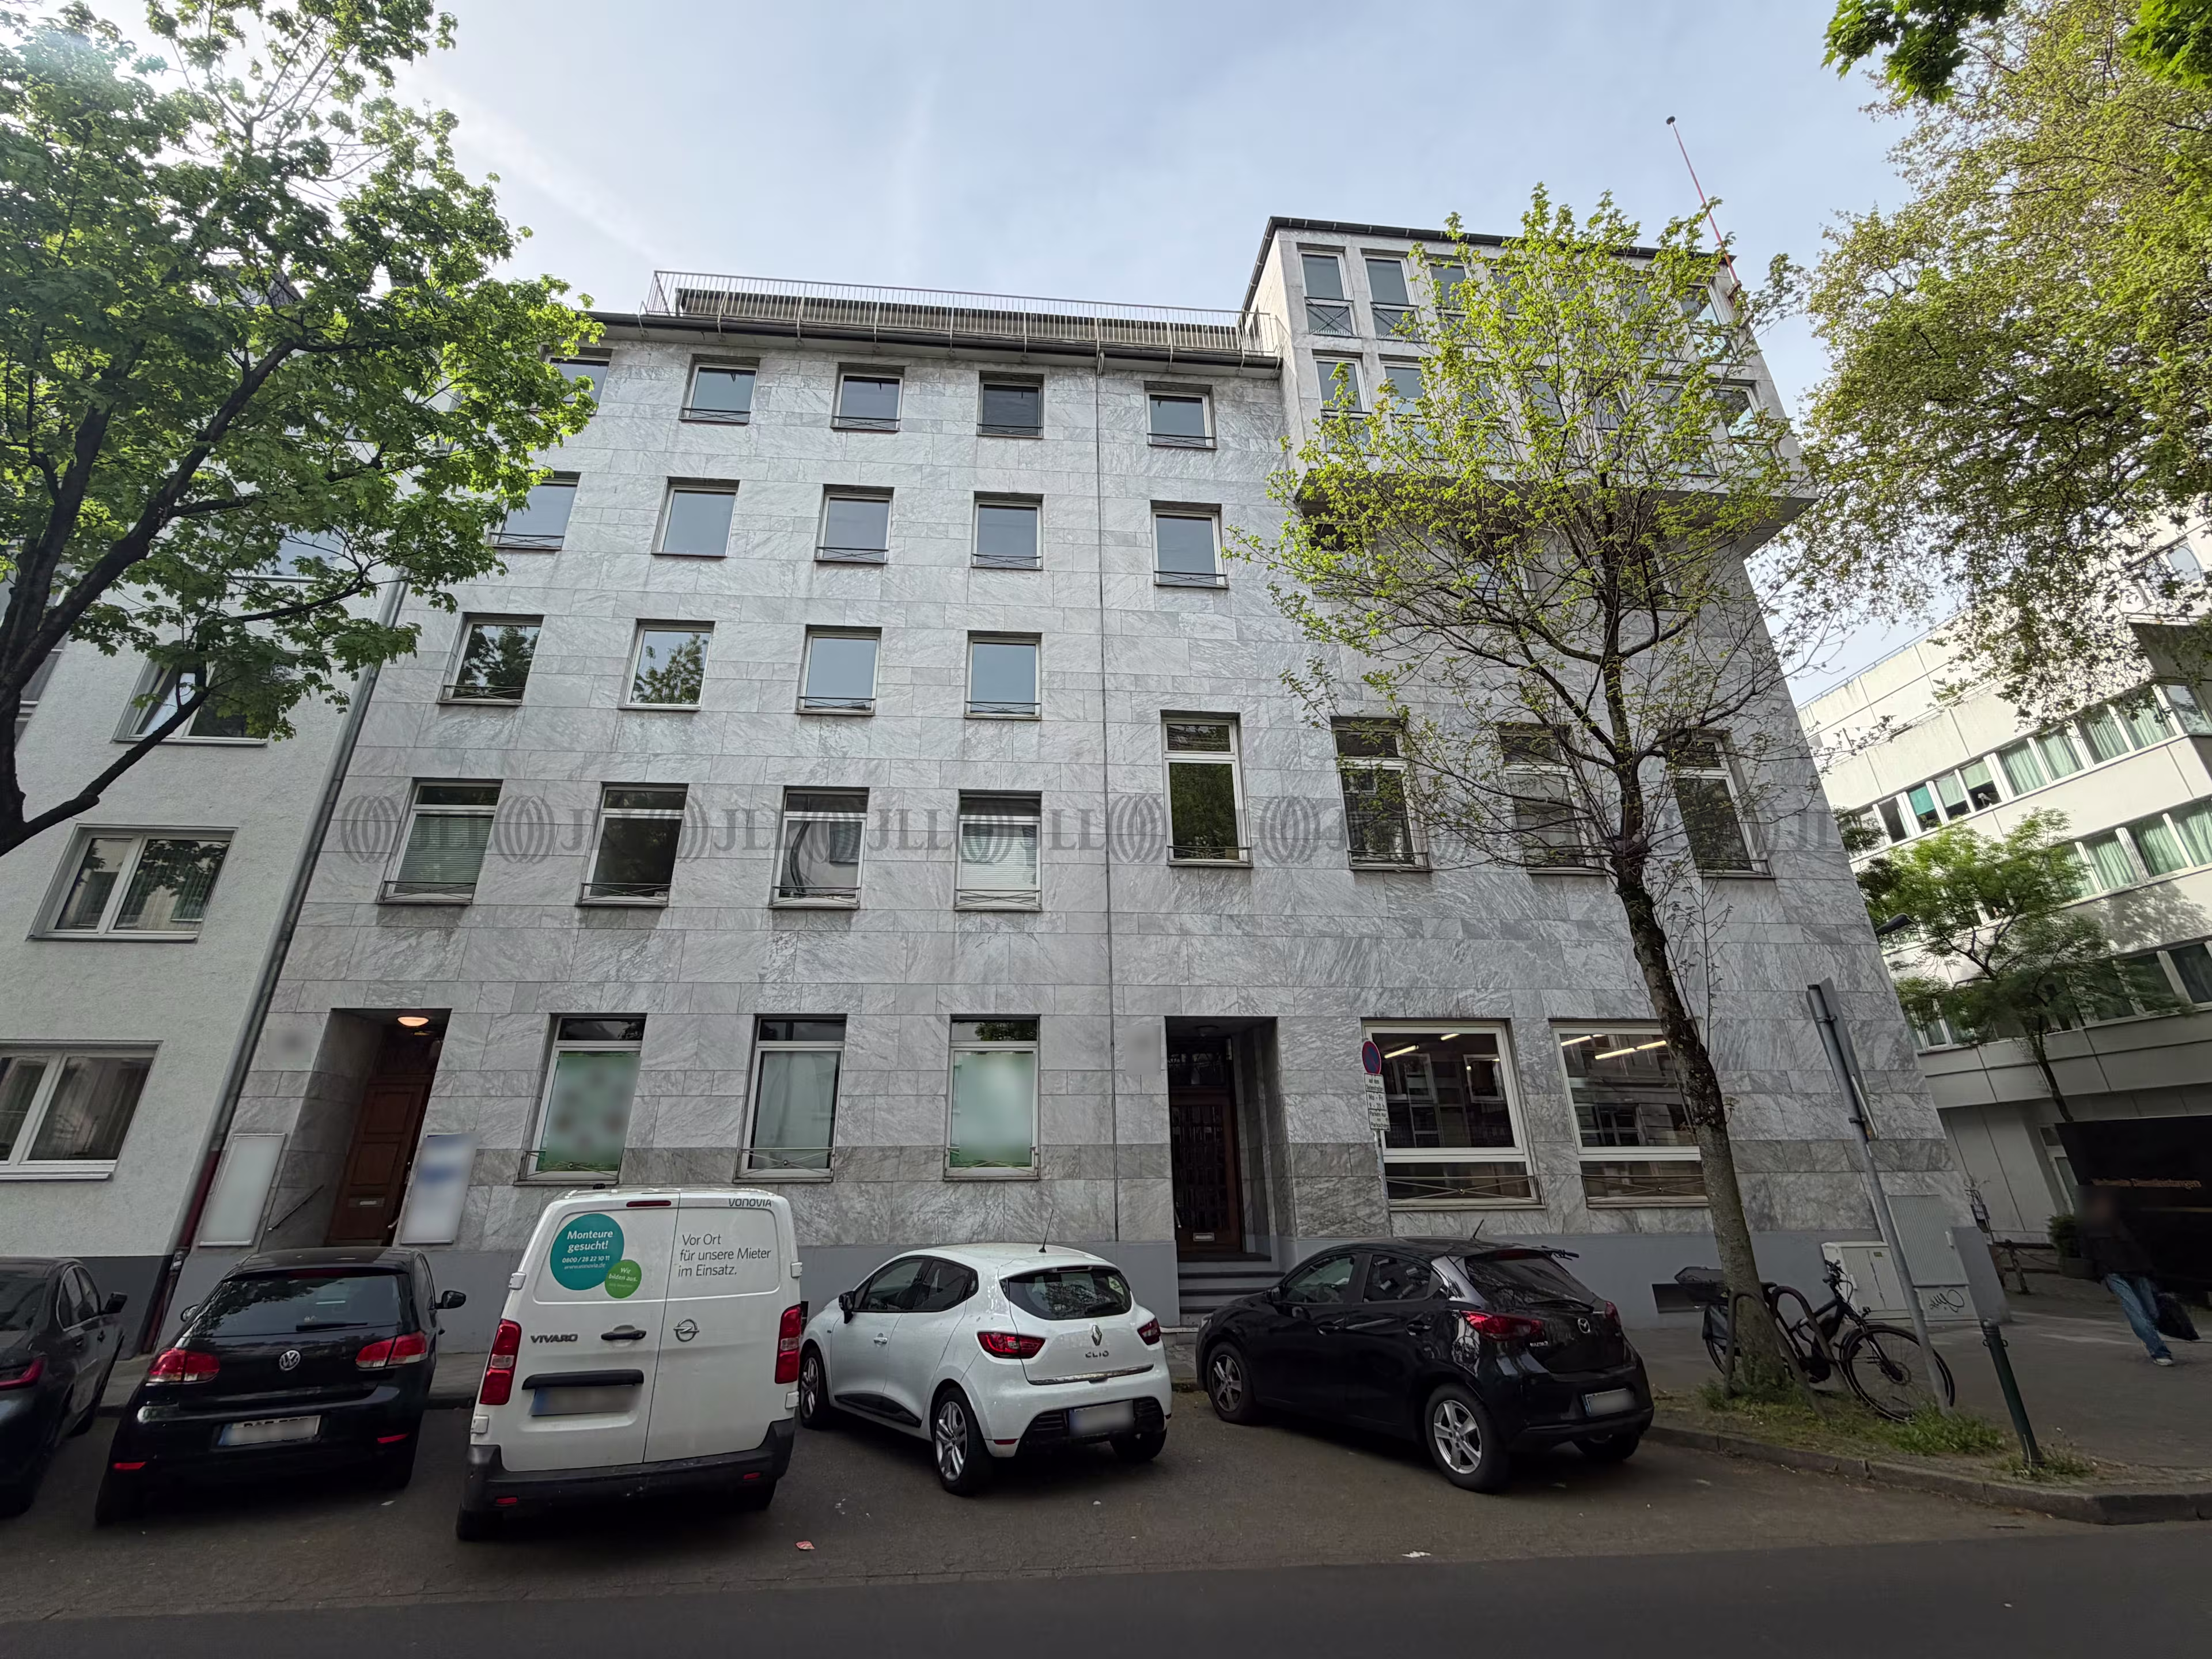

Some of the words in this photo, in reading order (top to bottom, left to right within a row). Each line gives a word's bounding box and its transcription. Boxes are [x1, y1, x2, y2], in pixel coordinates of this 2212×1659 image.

[567, 1230, 613, 1240] Monteure
[682, 1233, 701, 1245] Vor
[703, 1233, 721, 1245] Ort
[567, 1240, 608, 1253] gesucht!
[680, 1249, 695, 1261] für
[698, 1251, 734, 1260] unsere
[737, 1248, 771, 1259] Mieter
[678, 1265, 692, 1277] im
[696, 1264, 737, 1277] Einsatz.
[531, 1334, 578, 1343] VIVARO
